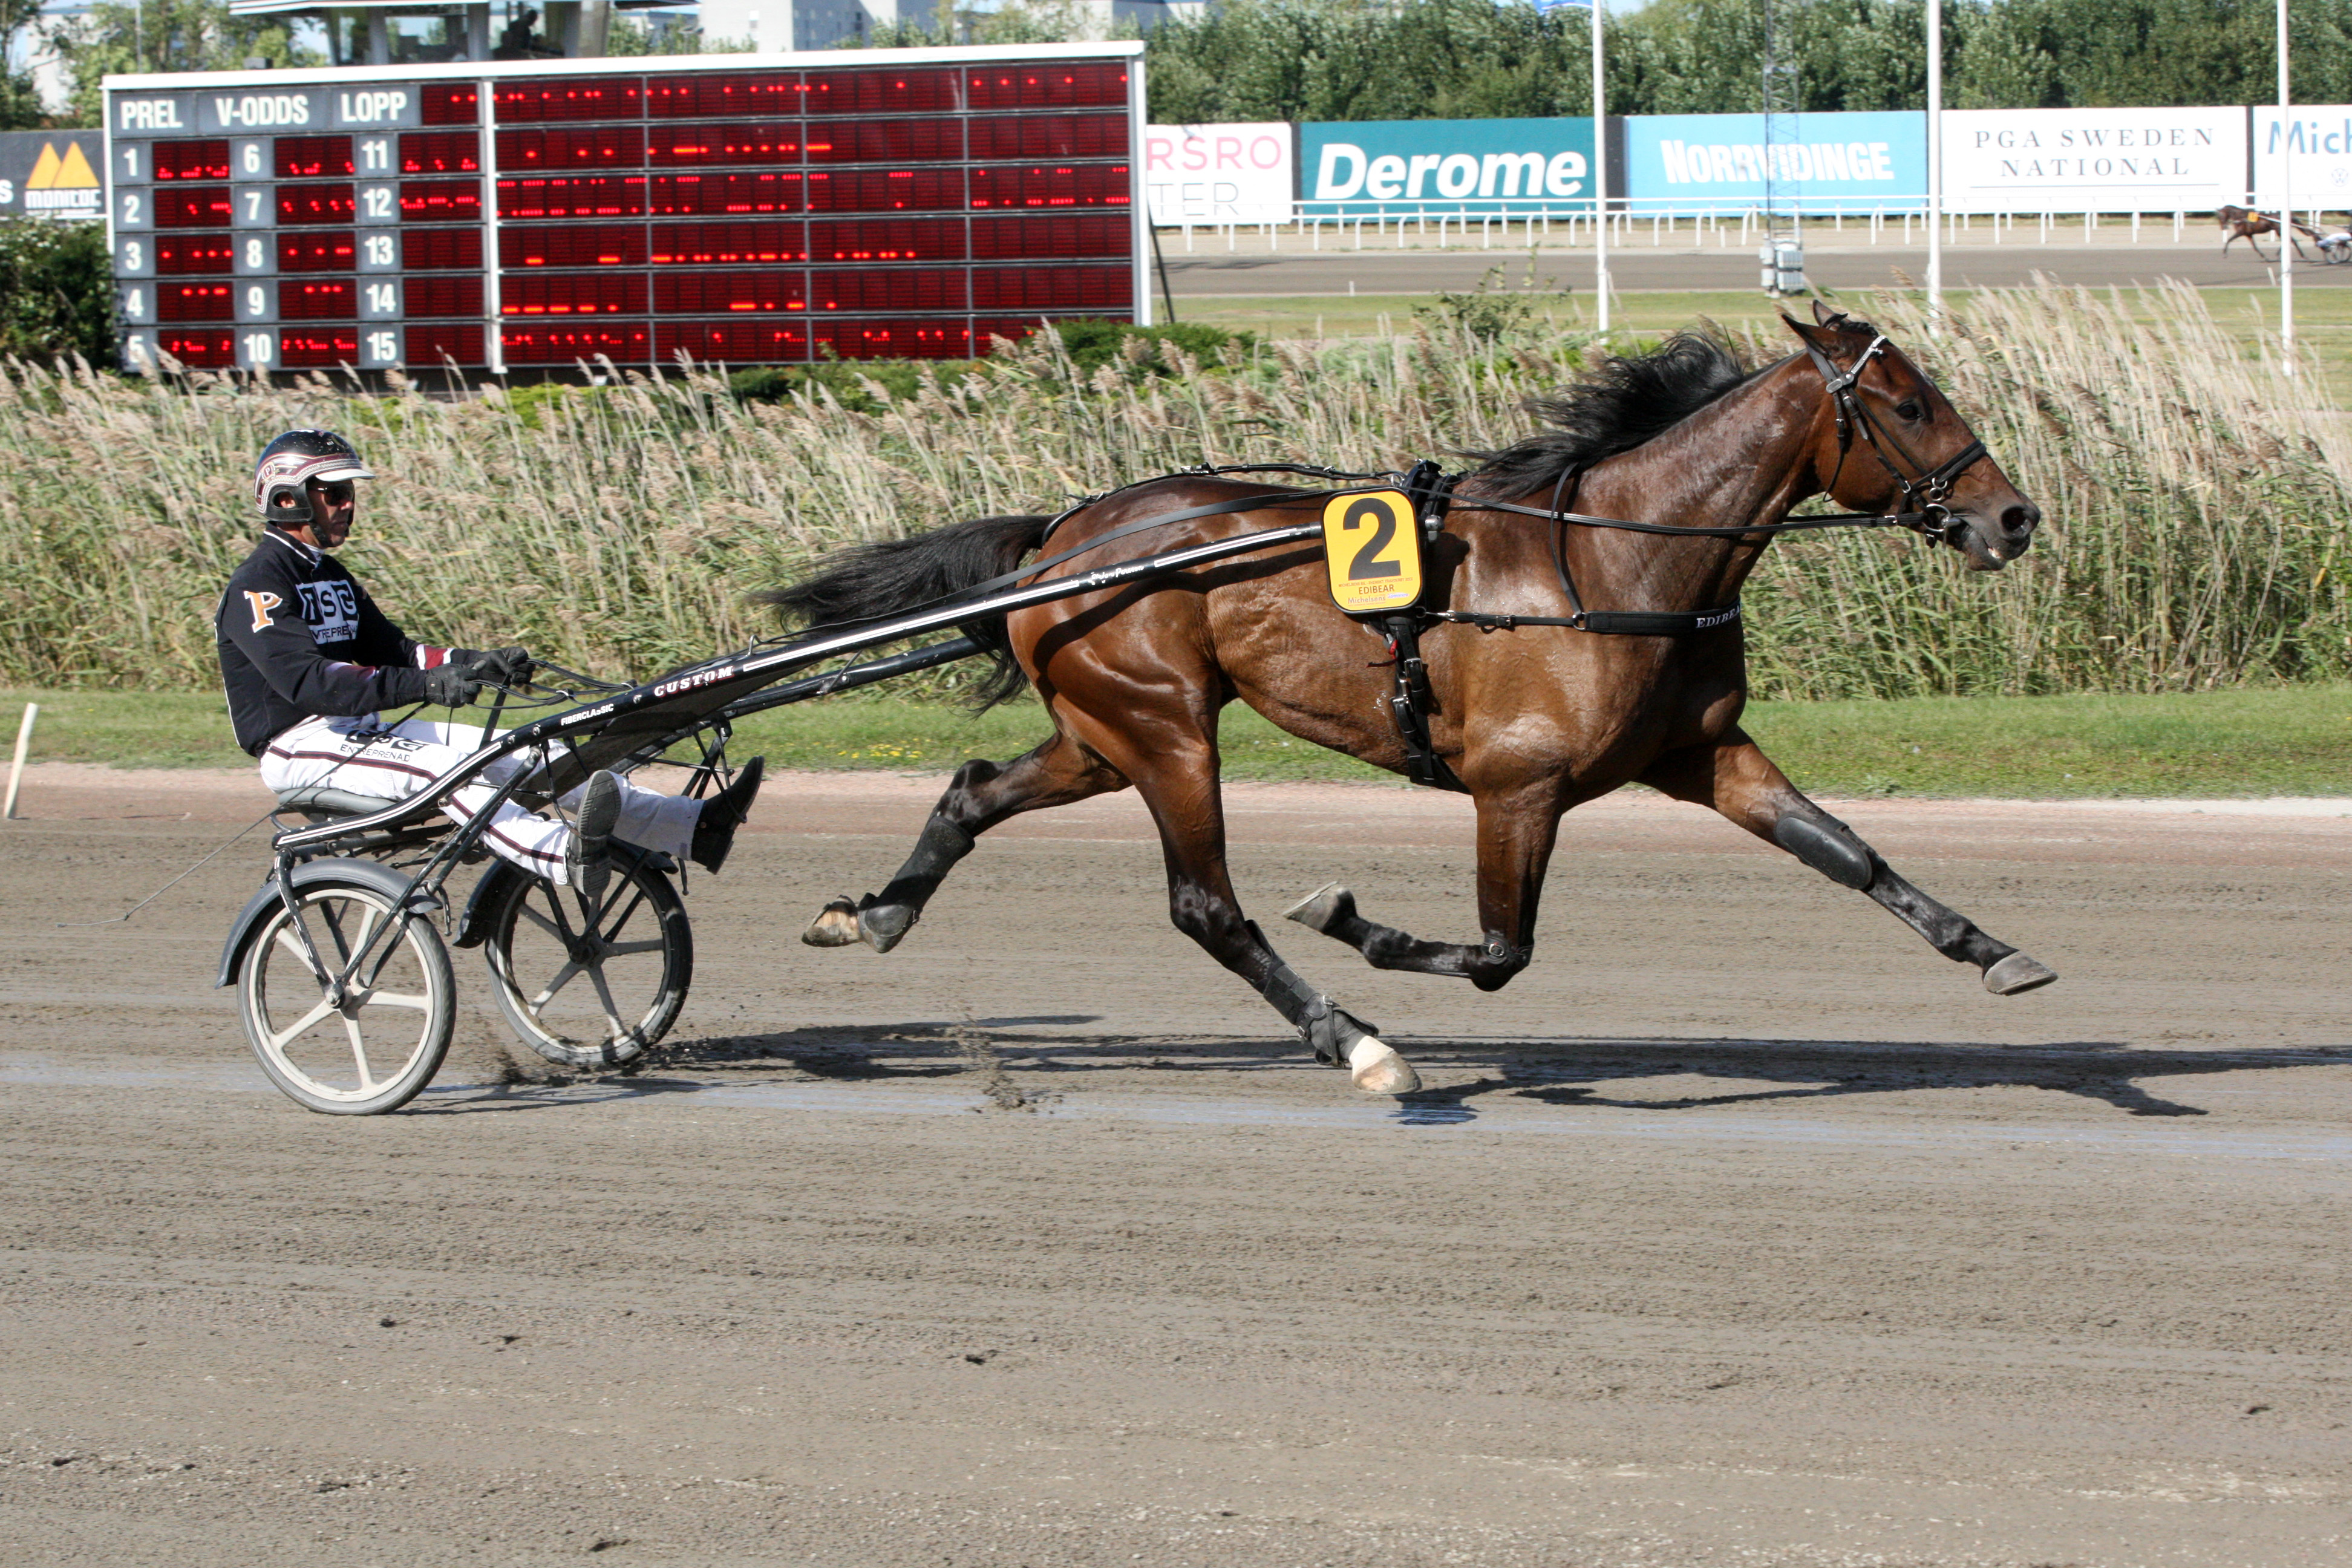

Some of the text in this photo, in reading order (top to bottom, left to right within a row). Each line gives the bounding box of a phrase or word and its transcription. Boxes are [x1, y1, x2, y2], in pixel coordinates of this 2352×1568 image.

[121, 91, 407, 129] PREL V-ODDS LOPP
[1974, 128, 2213, 148] PGA SWEDEN
[123, 148, 138, 176] 1
[244, 144, 260, 173] 6
[361, 140, 388, 169] 11
[1315, 143, 1587, 200] Derome
[2001, 158, 2189, 177] NATIONAL
[124, 195, 140, 223] 2
[244, 192, 261, 220] 7
[362, 188, 392, 217] 12
[125, 236, 394, 270] 3 8 13
[126, 284, 396, 316] 4 9 14
[128, 335, 145, 363] 5
[243, 334, 272, 363] 10
[367, 332, 397, 361] 15
[1342, 498, 1401, 581] 2
[1348, 594, 1386, 604] Michelsens
[1359, 584, 1394, 595] EDIBEAR
[243, 590, 283, 633] P
[654, 665, 735, 697] CUSTOM
